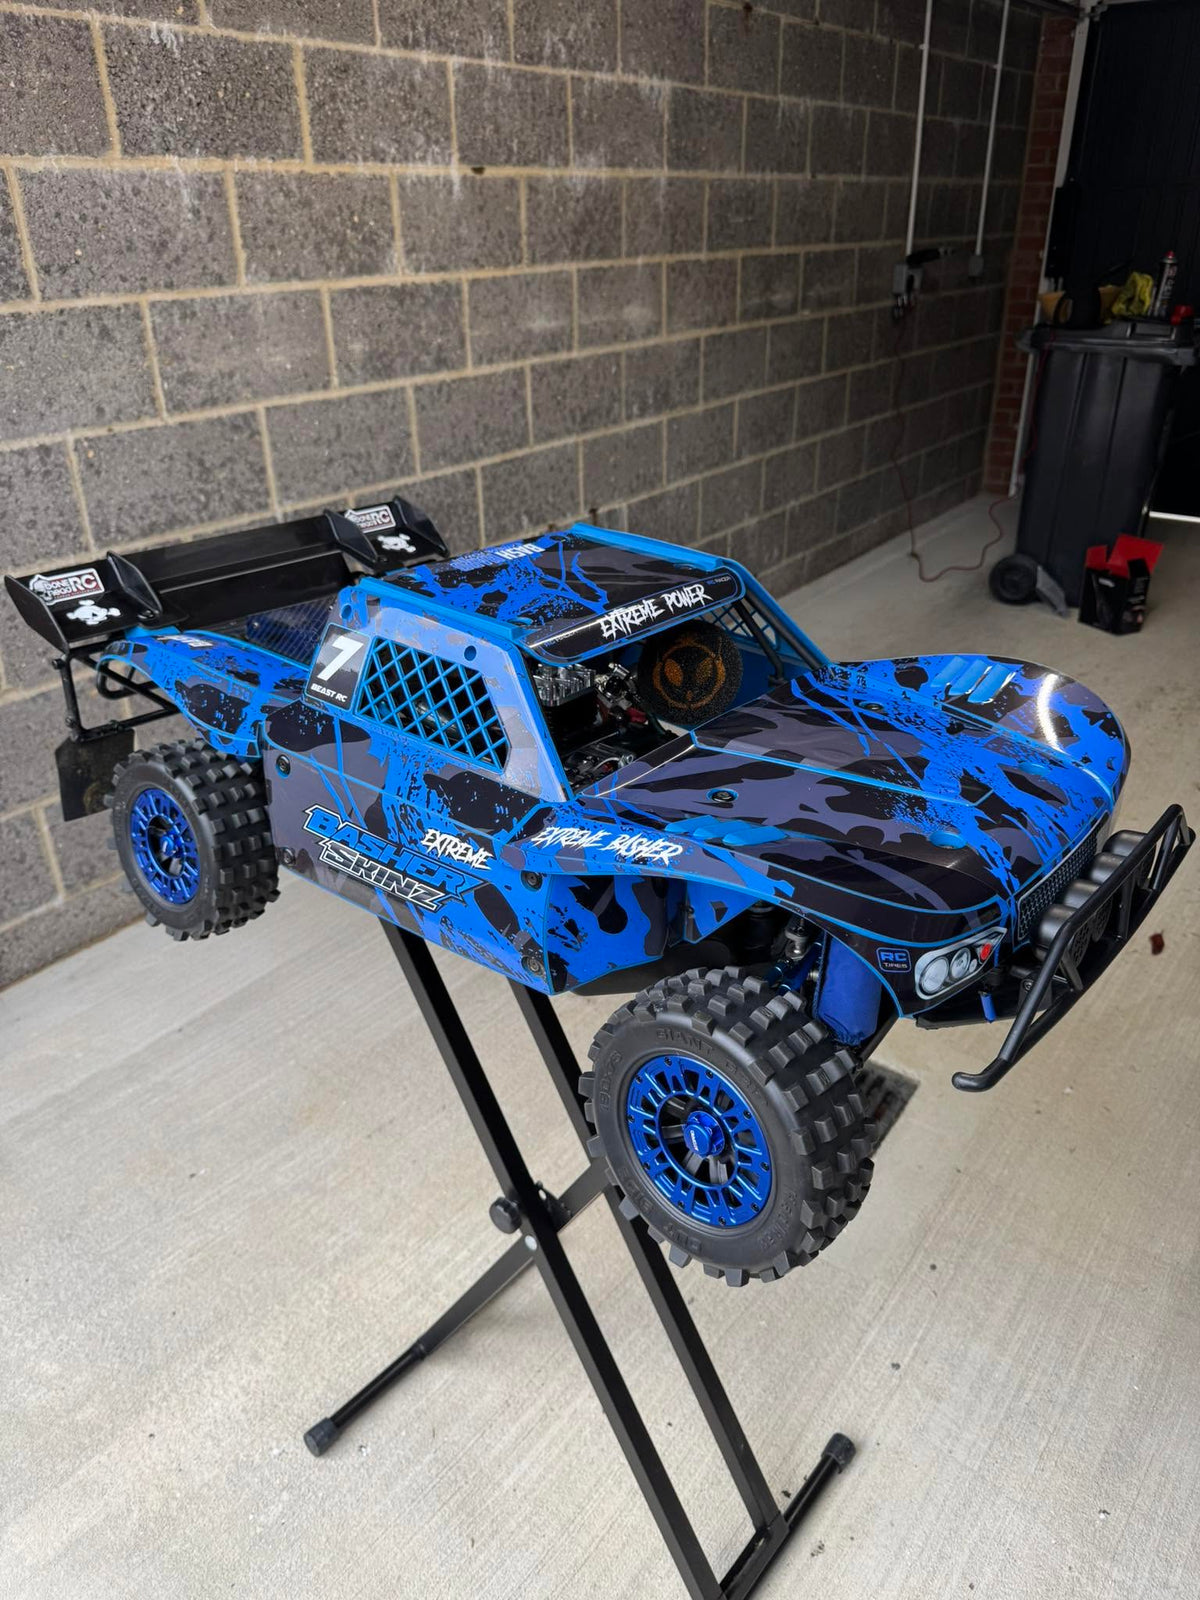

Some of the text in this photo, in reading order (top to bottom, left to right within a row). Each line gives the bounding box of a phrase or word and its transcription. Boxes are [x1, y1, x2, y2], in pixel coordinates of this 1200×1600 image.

[68, 574, 98, 592] RC
[600, 584, 714, 640] EXTREME POWER
[317, 635, 364, 682] 7
[310, 683, 348, 703] BEAST RC
[304, 804, 480, 897] BASHER
[421, 828, 495, 871] EXTREME
[530, 827, 683, 867] EXTREME BASHER
[319, 839, 446, 911] SKINZ
[880, 951, 907, 962] RC
